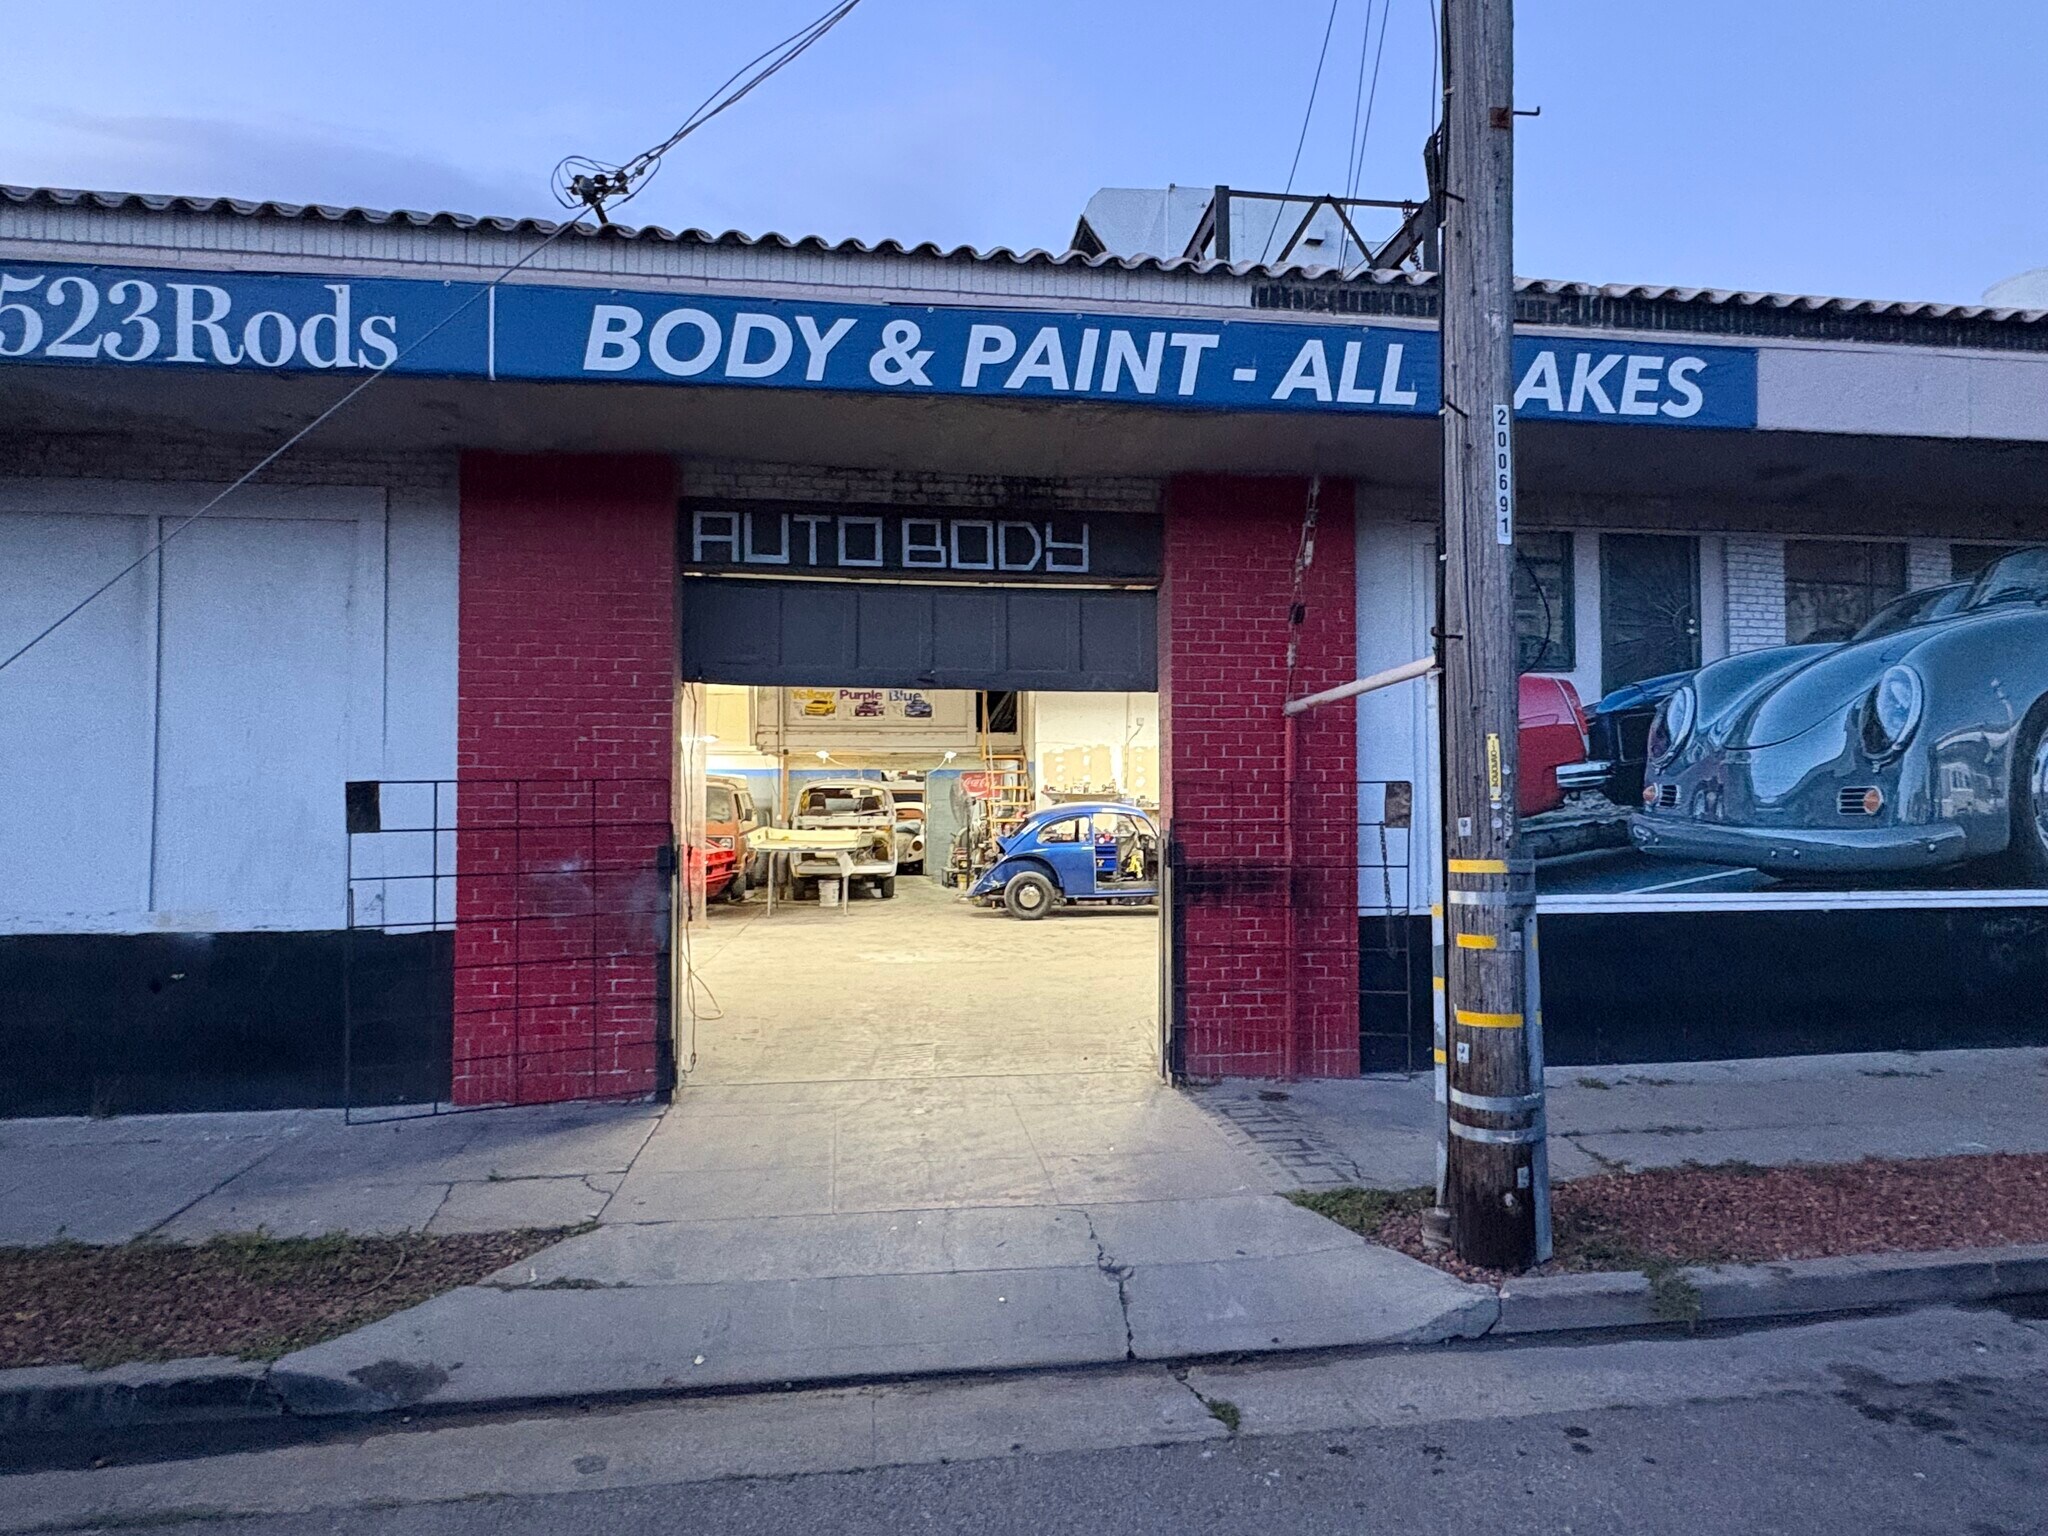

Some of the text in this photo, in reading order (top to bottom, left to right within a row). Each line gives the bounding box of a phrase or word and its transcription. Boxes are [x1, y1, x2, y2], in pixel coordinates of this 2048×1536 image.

[583, 304, 858, 382] BODY
[869, 319, 936, 386] &
[960, 324, 1220, 396] PAINT
[1271, 339, 1418, 406] ALL
[1513, 351, 1707, 419] AKES
[1497, 409, 1509, 534] 200691
[693, 511, 1089, 573] AUTO BODY
[791, 689, 836, 700] Yellow
[839, 689, 883, 702] Purple
